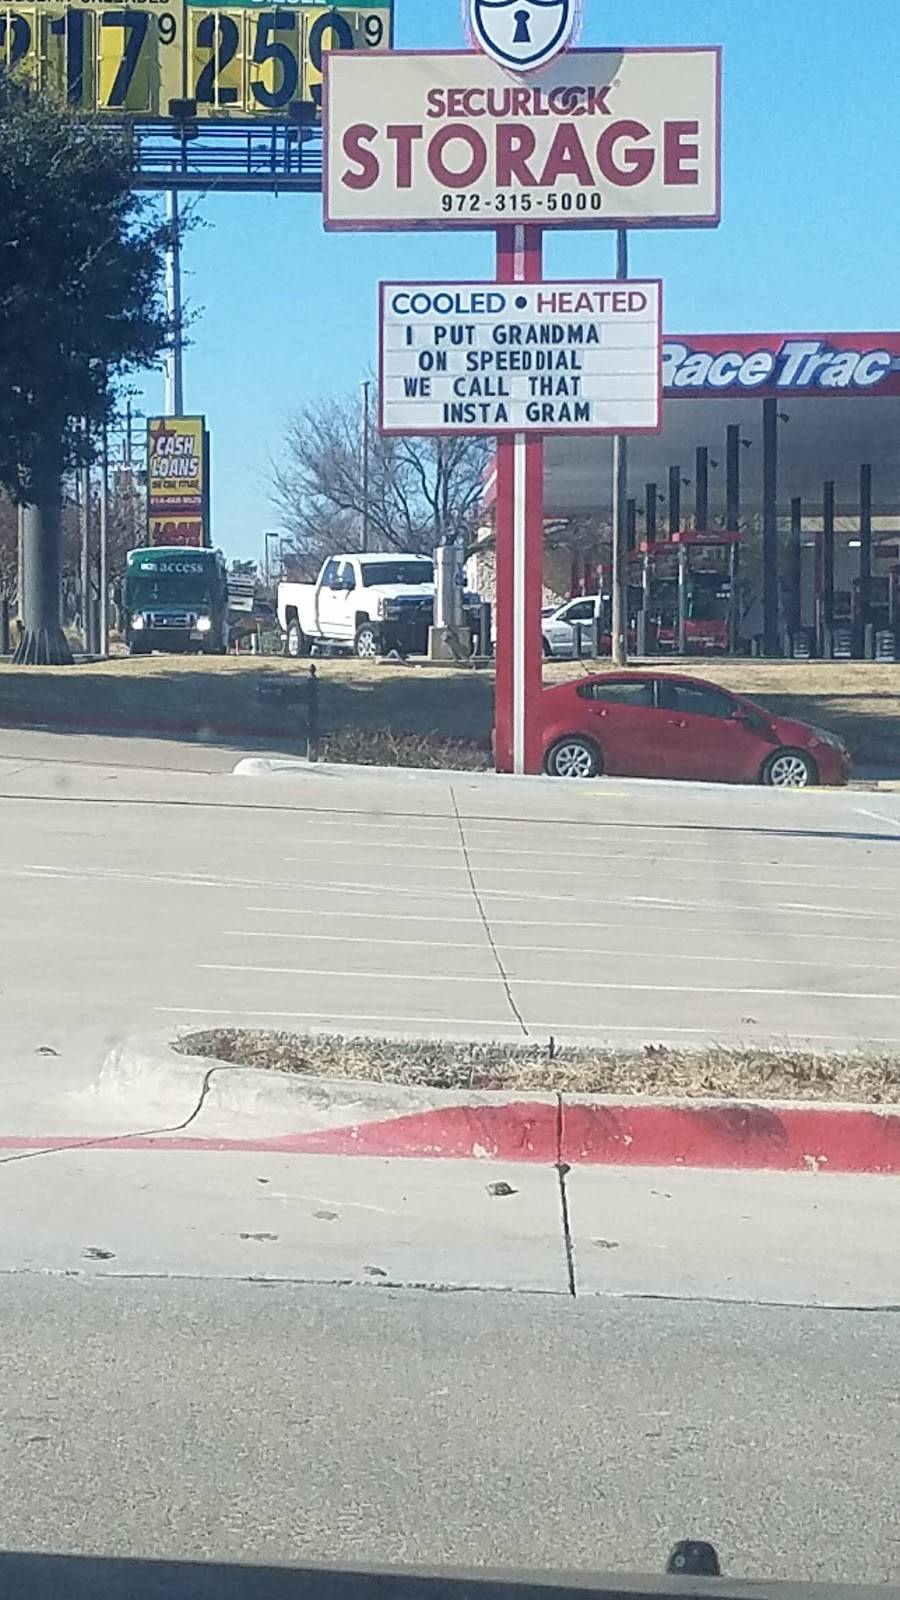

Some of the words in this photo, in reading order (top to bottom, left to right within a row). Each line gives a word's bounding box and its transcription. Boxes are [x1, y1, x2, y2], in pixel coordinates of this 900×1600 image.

[426, 86, 612, 118] SECURLOCK
[341, 120, 699, 190] STORAGE
[441, 193, 602, 212] 972-315-5000
[392, 293, 506, 314] COOLED
[537, 292, 647, 313] HEATED
[405, 326, 412, 345] I
[434, 326, 475, 345] PUT
[493, 325, 599, 345] GRANDMA
[418, 351, 447, 371] ON
[466, 351, 582, 371] SPEEDDIAL
[404, 377, 431, 397] WE
[453, 377, 509, 397] CALL
[529, 376, 580, 396] THAT
[443, 403, 508, 423] INSTA
[526, 402, 590, 422] GRAM
[156, 436, 194, 455] CASH
[151, 457, 200, 477] LOANS
